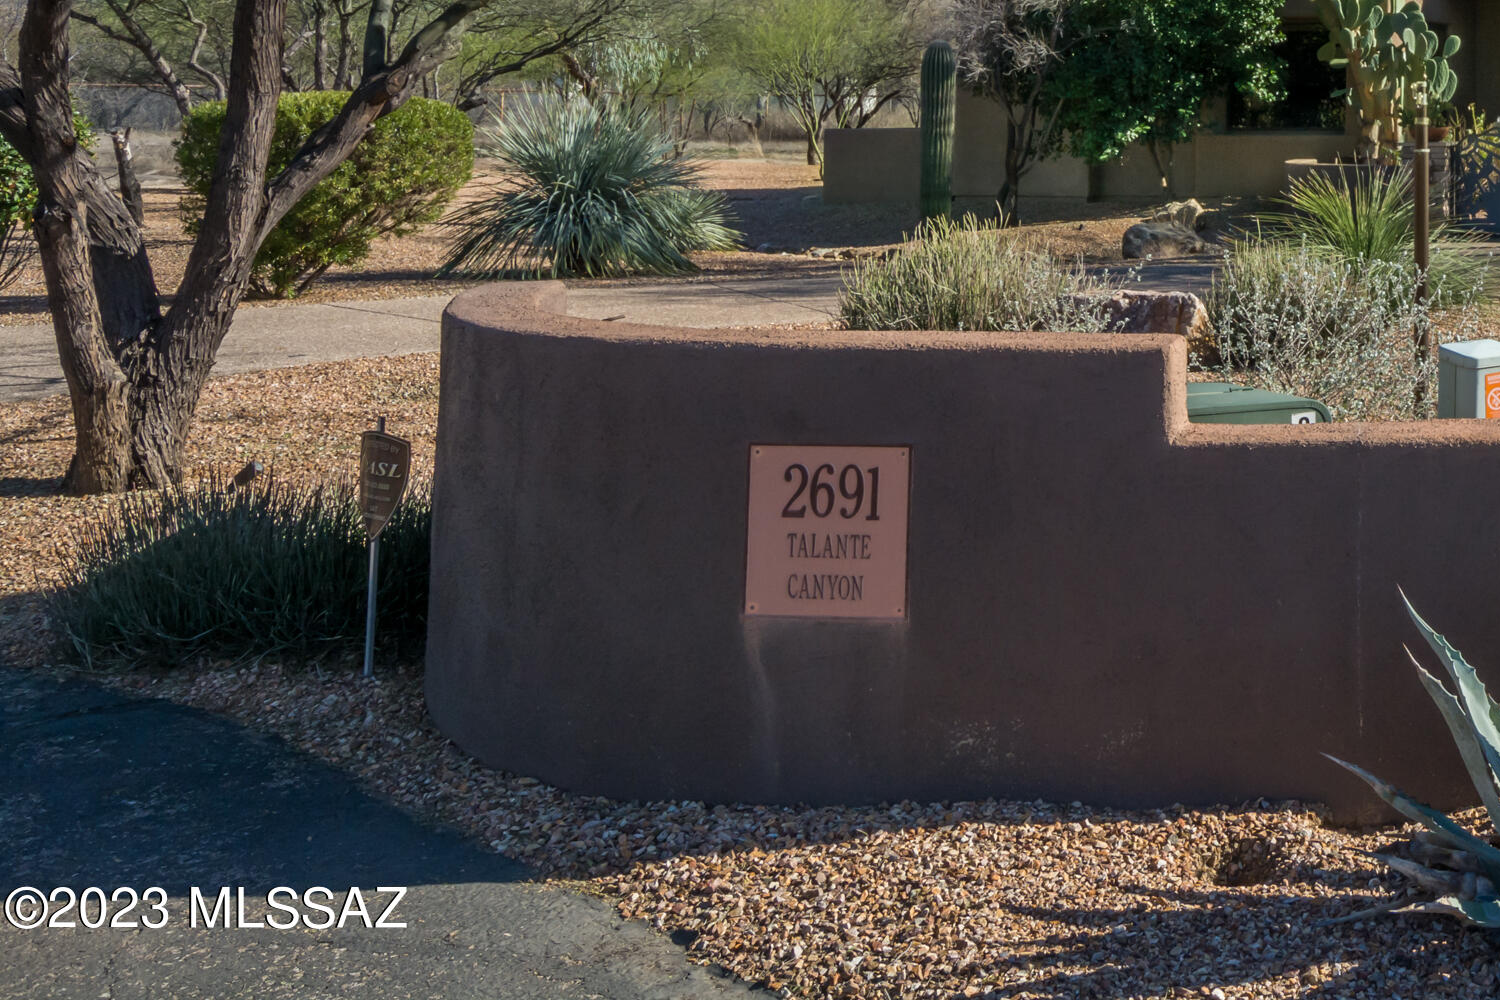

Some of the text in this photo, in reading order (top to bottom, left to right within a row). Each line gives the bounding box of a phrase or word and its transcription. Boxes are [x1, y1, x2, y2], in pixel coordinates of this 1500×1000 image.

[781, 463, 880, 521] 2691
[787, 533, 872, 560] TALANTE
[787, 573, 864, 601] CANYON
